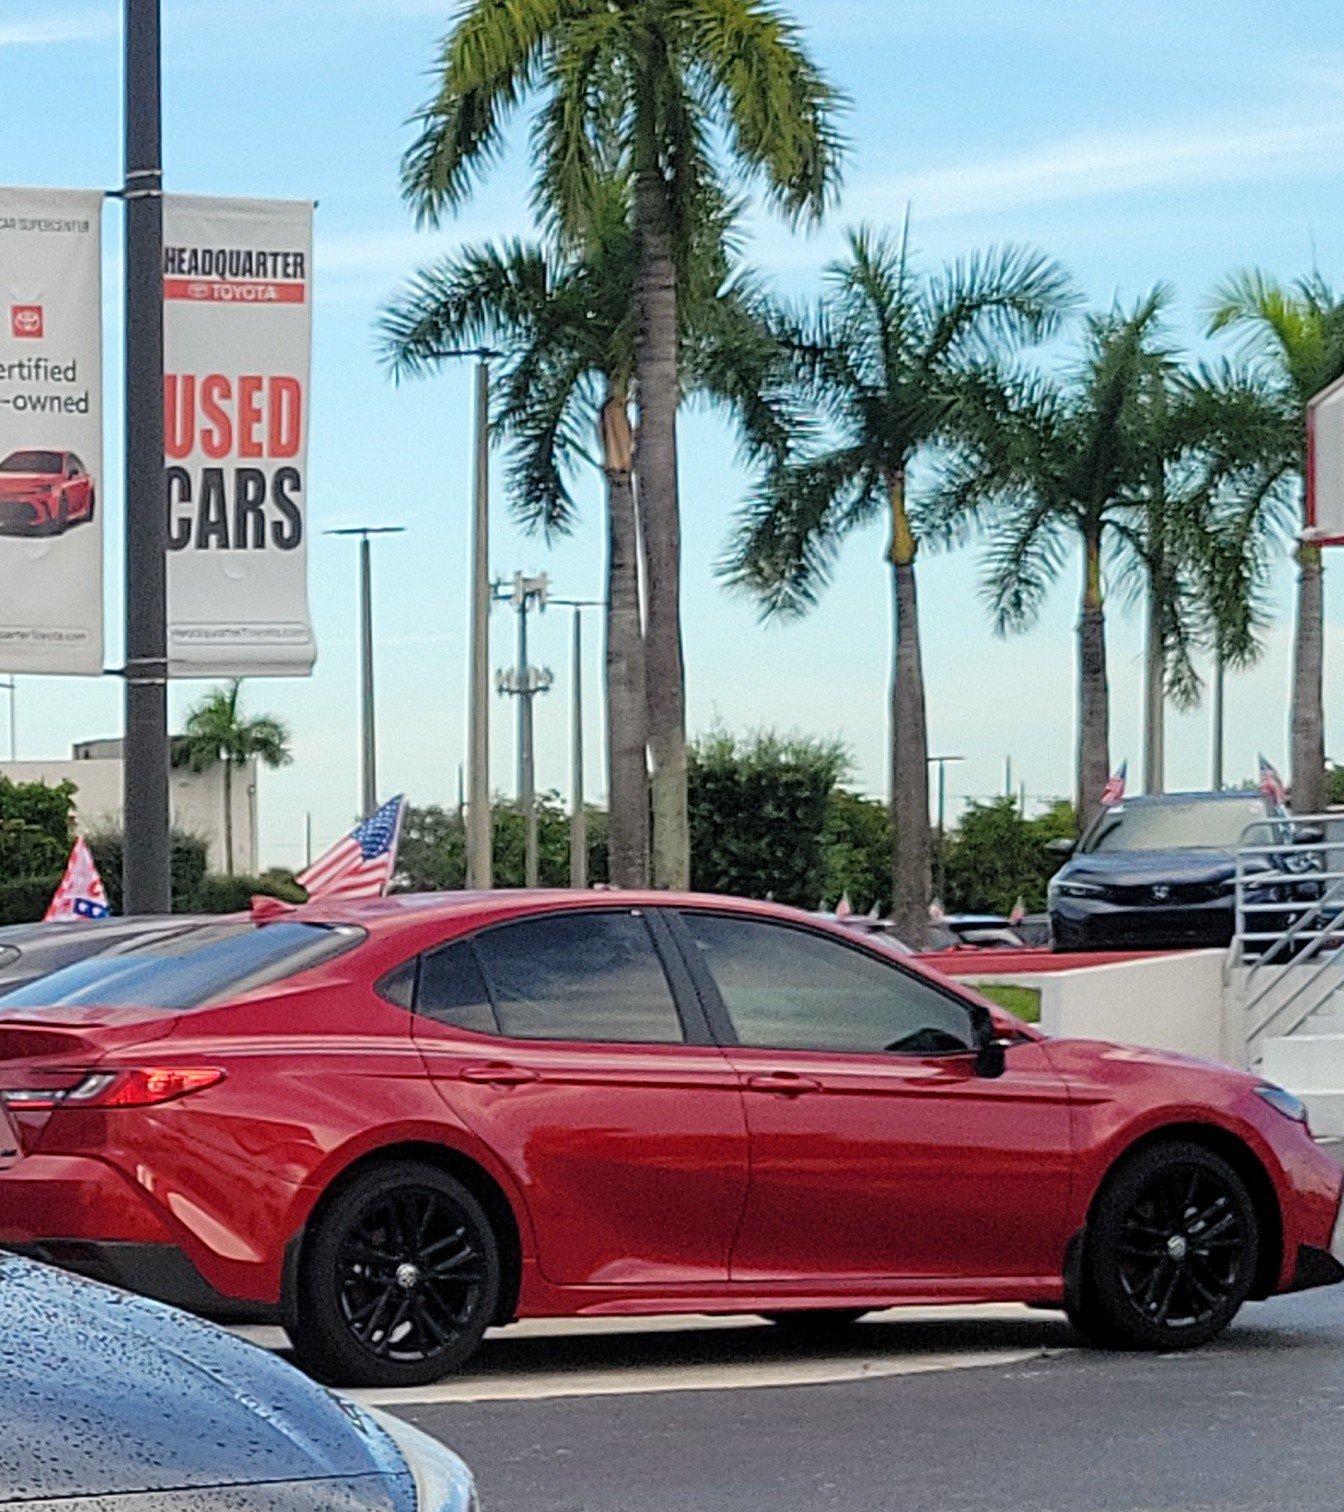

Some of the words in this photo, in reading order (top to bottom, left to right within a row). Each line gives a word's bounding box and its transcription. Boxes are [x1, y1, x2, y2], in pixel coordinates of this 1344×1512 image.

[164, 247, 305, 281] HEADQUARTER
[212, 284, 278, 300] TOYOTA
[164, 373, 302, 460] USED
[164, 466, 303, 551] CARS
